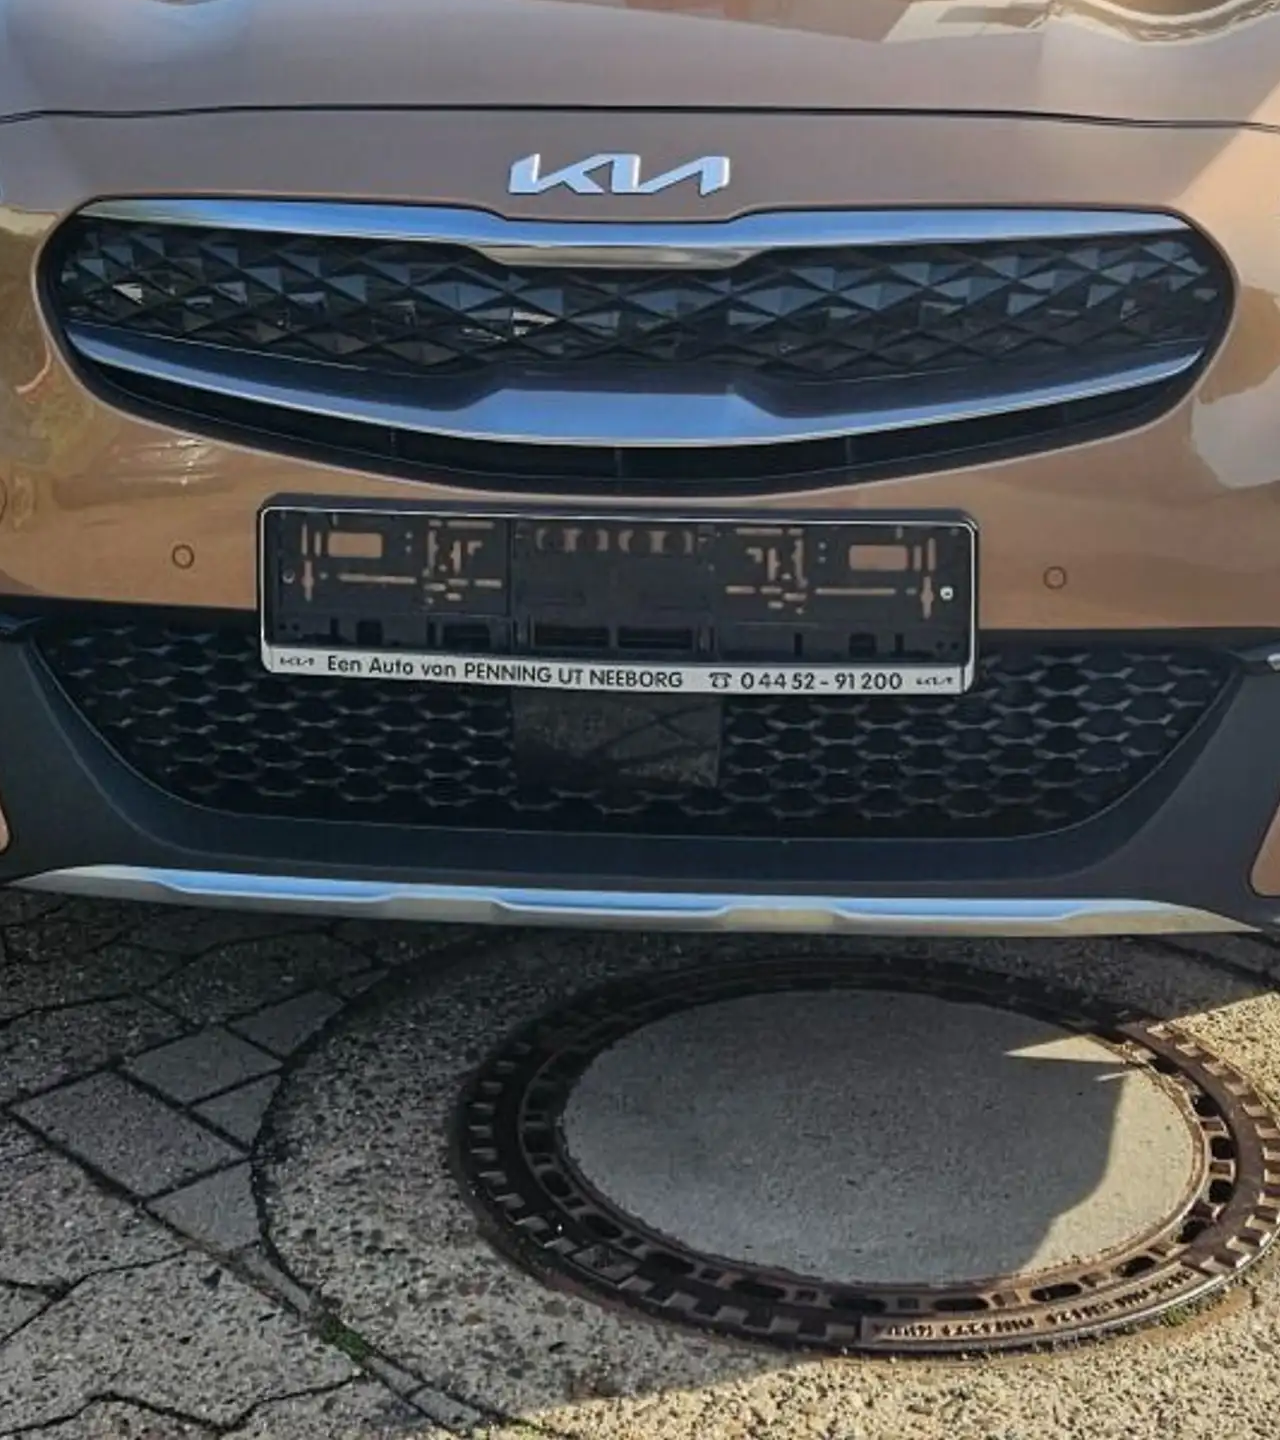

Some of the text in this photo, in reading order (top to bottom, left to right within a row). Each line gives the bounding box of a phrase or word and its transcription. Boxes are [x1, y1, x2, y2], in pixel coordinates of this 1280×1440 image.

[508, 153, 731, 197] KIA
[327, 655, 362, 673] Een
[369, 657, 414, 676] Auto
[464, 662, 552, 683] PENNING
[558, 669, 585, 684] UT
[589, 669, 683, 689] NEEBORG
